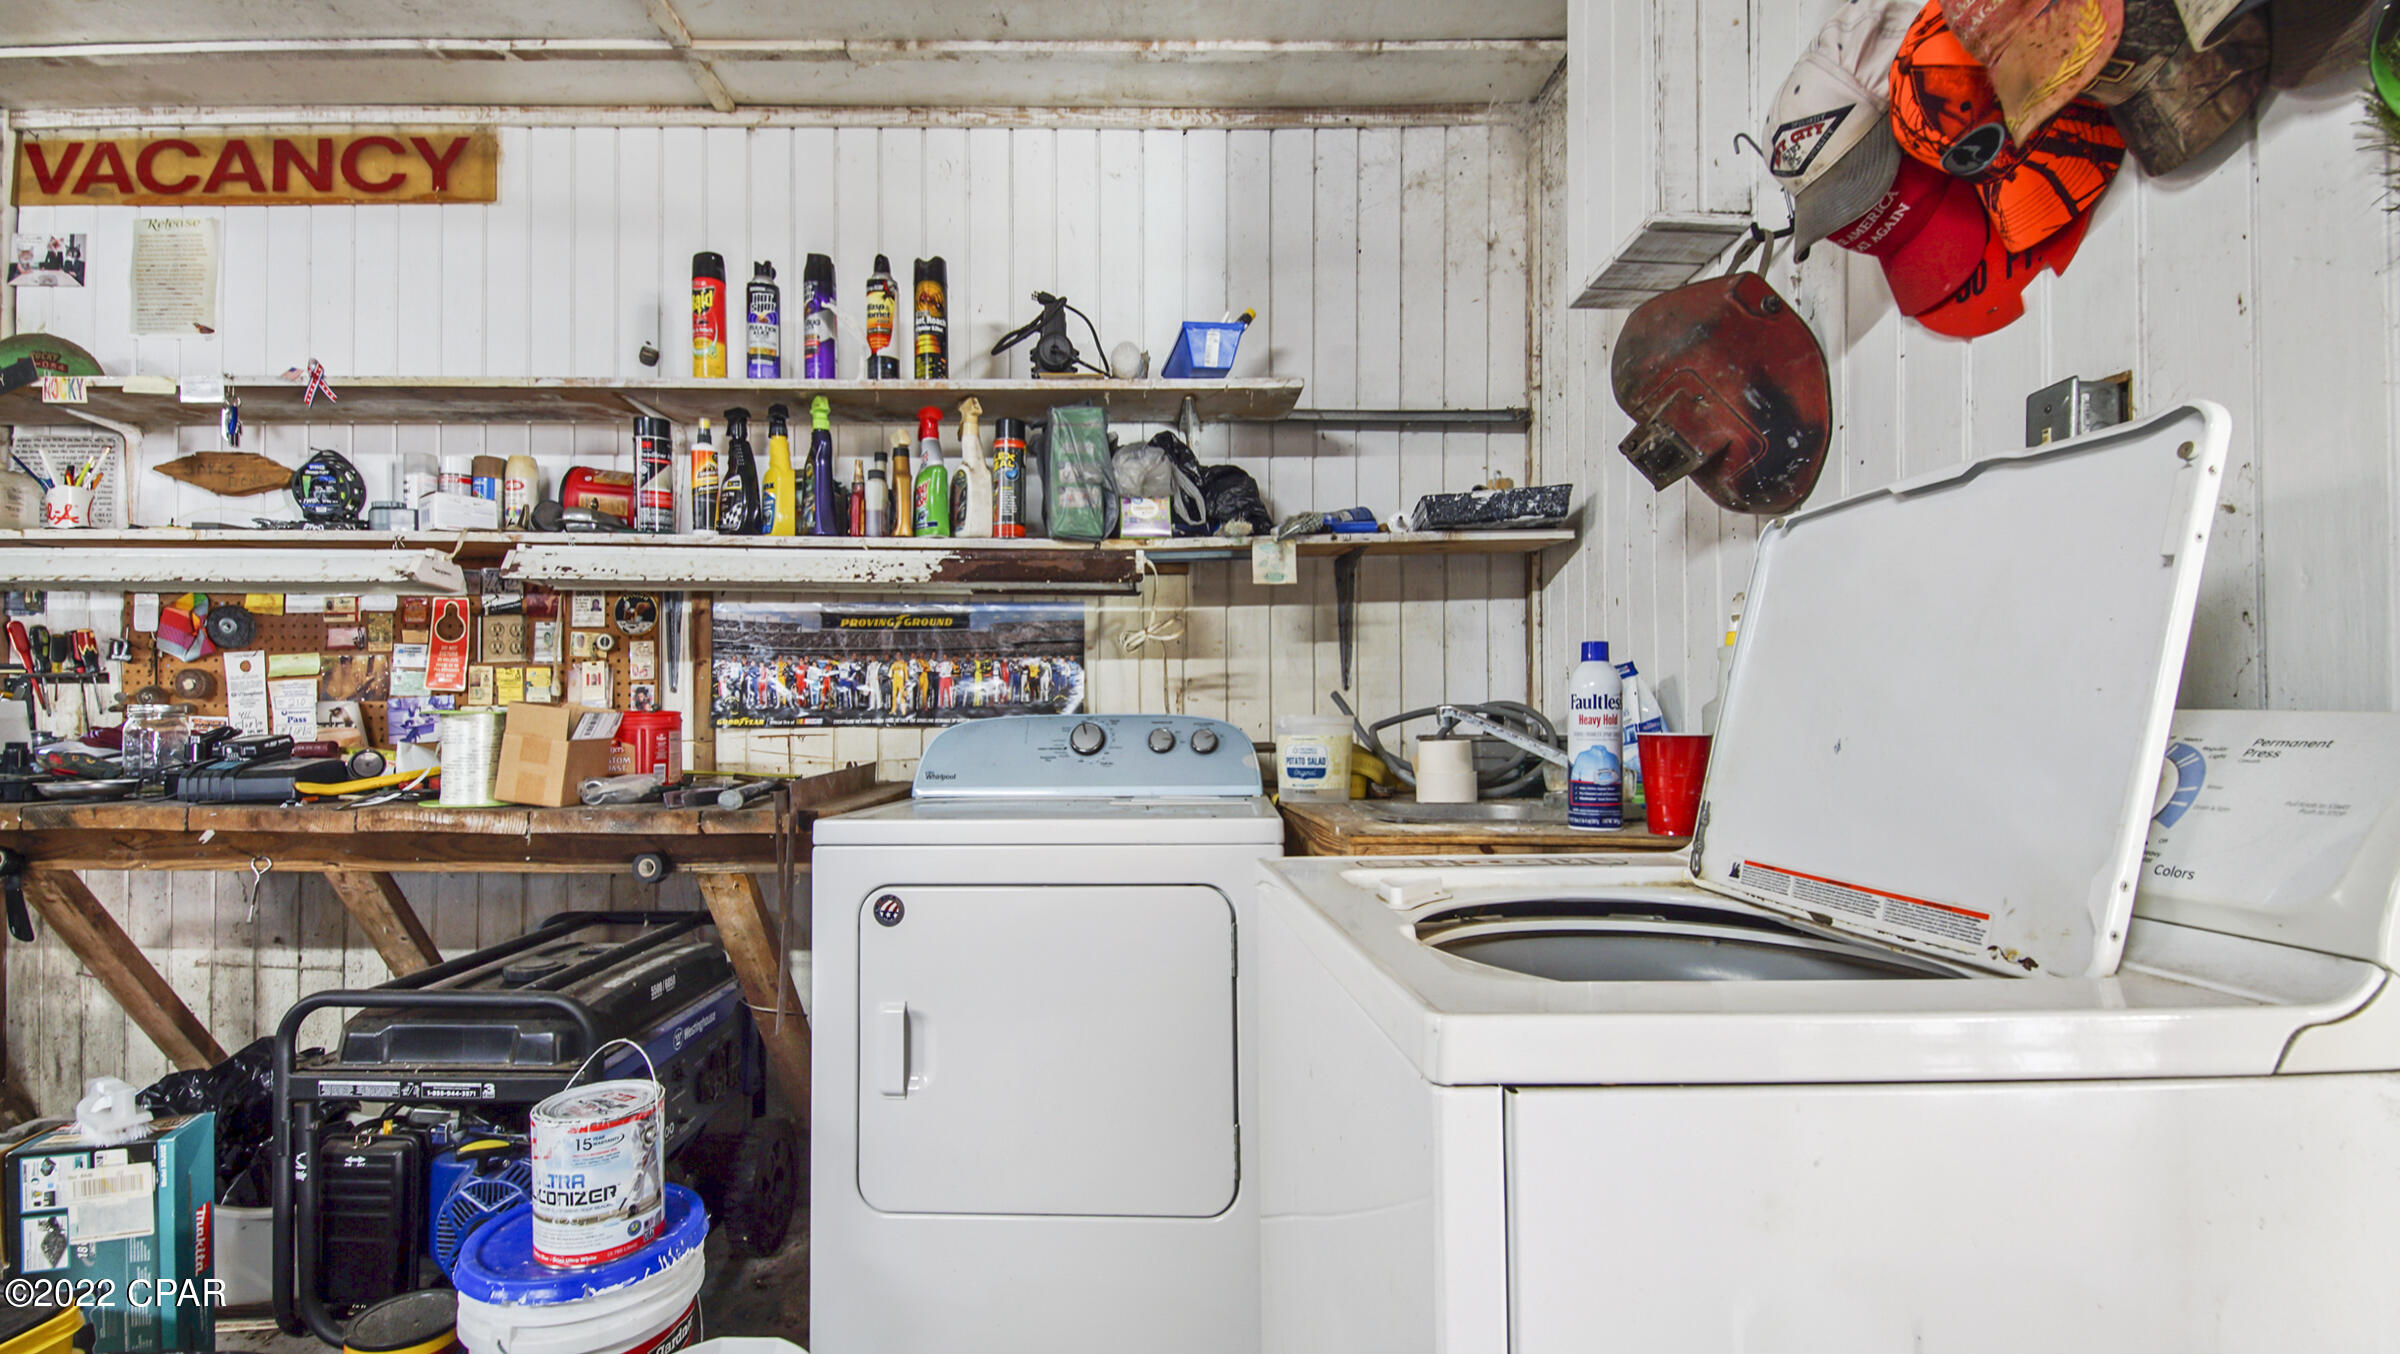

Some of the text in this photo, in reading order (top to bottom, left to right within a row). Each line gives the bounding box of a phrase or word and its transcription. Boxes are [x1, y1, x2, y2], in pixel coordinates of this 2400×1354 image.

[24, 136, 471, 195] VACANCY
[1847, 191, 1899, 242] AMERICA
[1870, 202, 1911, 244] AGAIN
[146, 218, 201, 232] Release
[840, 617, 954, 628] PROVING GROUND
[287, 715, 307, 723] Pass
[716, 716, 765, 726] GOODYEAR
[1578, 713, 1618, 728] Heavy Hold
[2253, 738, 2335, 749] Permanent
[2243, 748, 2282, 759] Press
[1286, 756, 1326, 766] POTATO SALAD
[925, 772, 956, 782] Whirlpool
[2154, 864, 2195, 880] Colors
[683, 1010, 716, 1041] Westinghouse
[576, 1138, 593, 1152] 15
